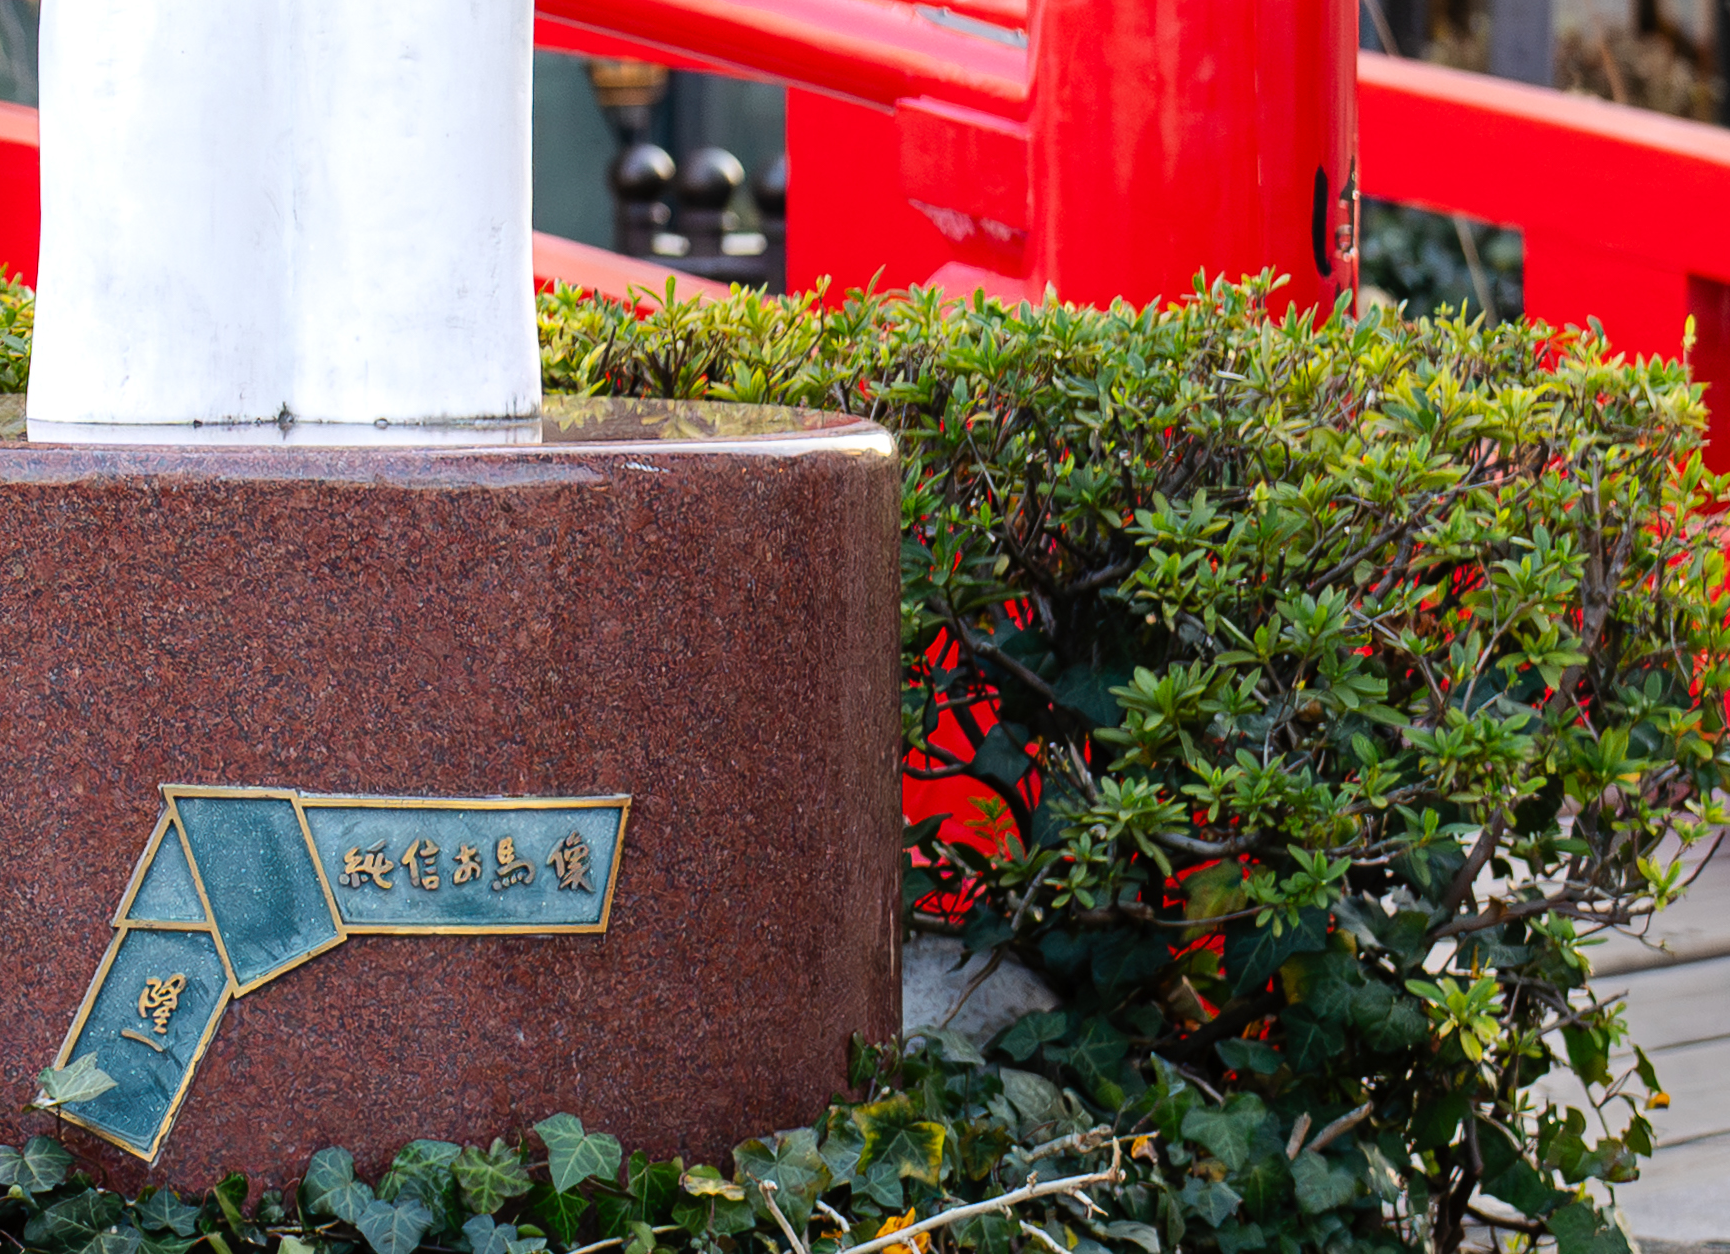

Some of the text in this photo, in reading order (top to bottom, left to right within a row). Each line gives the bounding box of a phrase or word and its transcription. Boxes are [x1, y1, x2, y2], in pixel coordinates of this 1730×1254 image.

[338, 830, 596, 893] 純信お馬像
